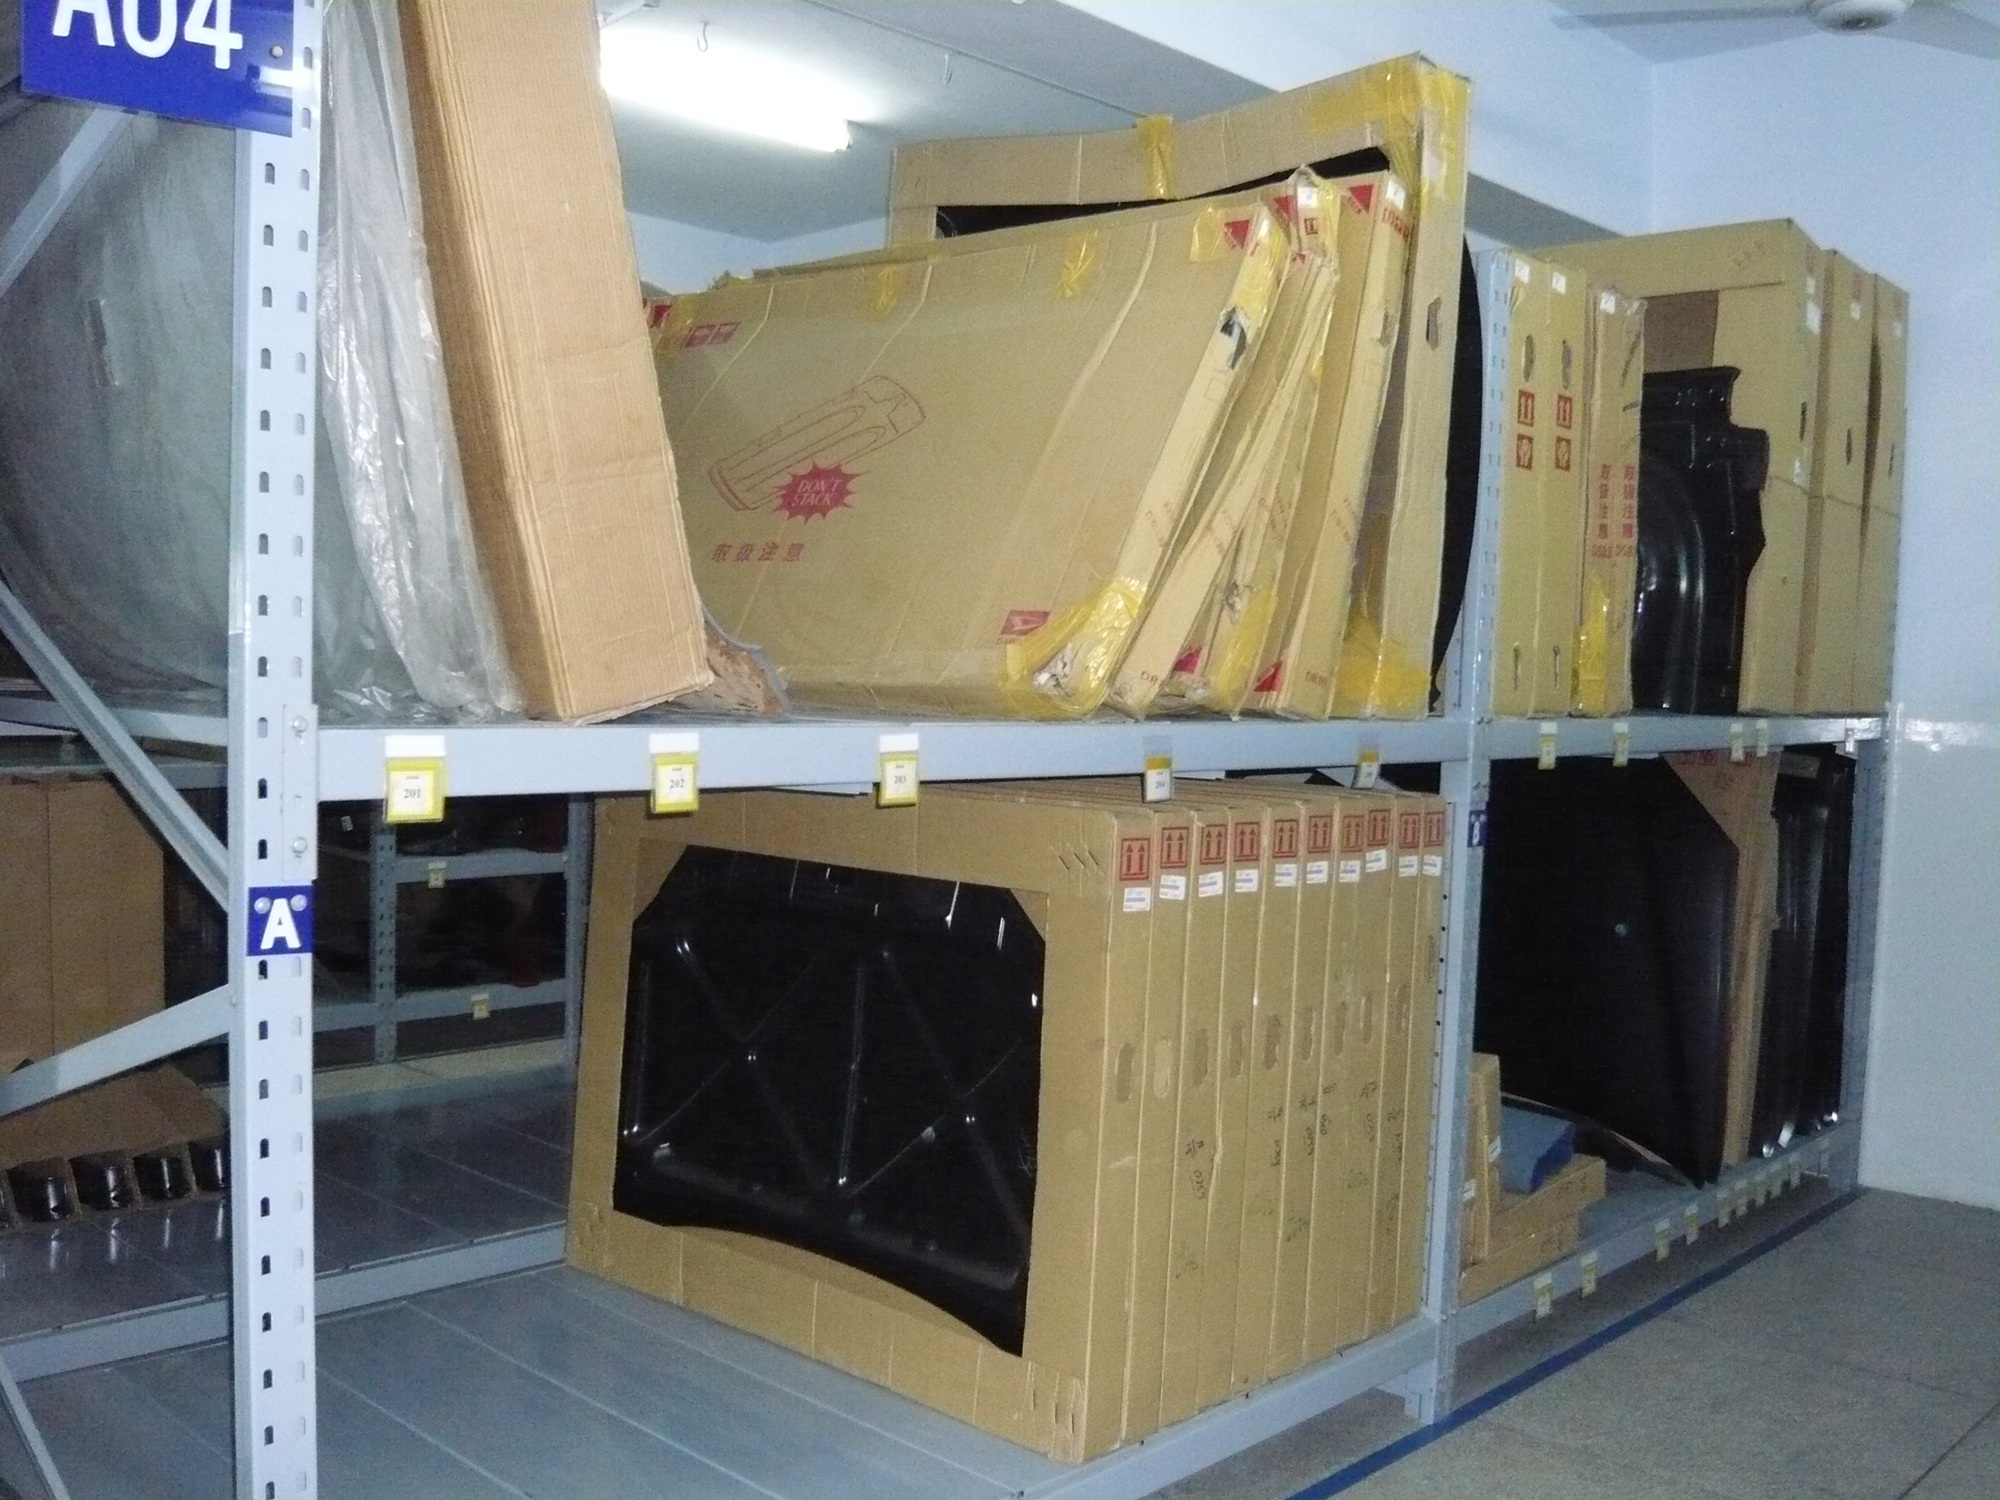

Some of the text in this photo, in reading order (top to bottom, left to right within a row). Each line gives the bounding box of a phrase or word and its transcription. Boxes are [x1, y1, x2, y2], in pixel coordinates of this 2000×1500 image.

[52, 0, 243, 69] A04
[797, 477, 843, 493] DON'T
[792, 492, 834, 506] STACK
[669, 778, 685, 789] 202
[403, 788, 421, 799] 201
[260, 898, 301, 950] A
